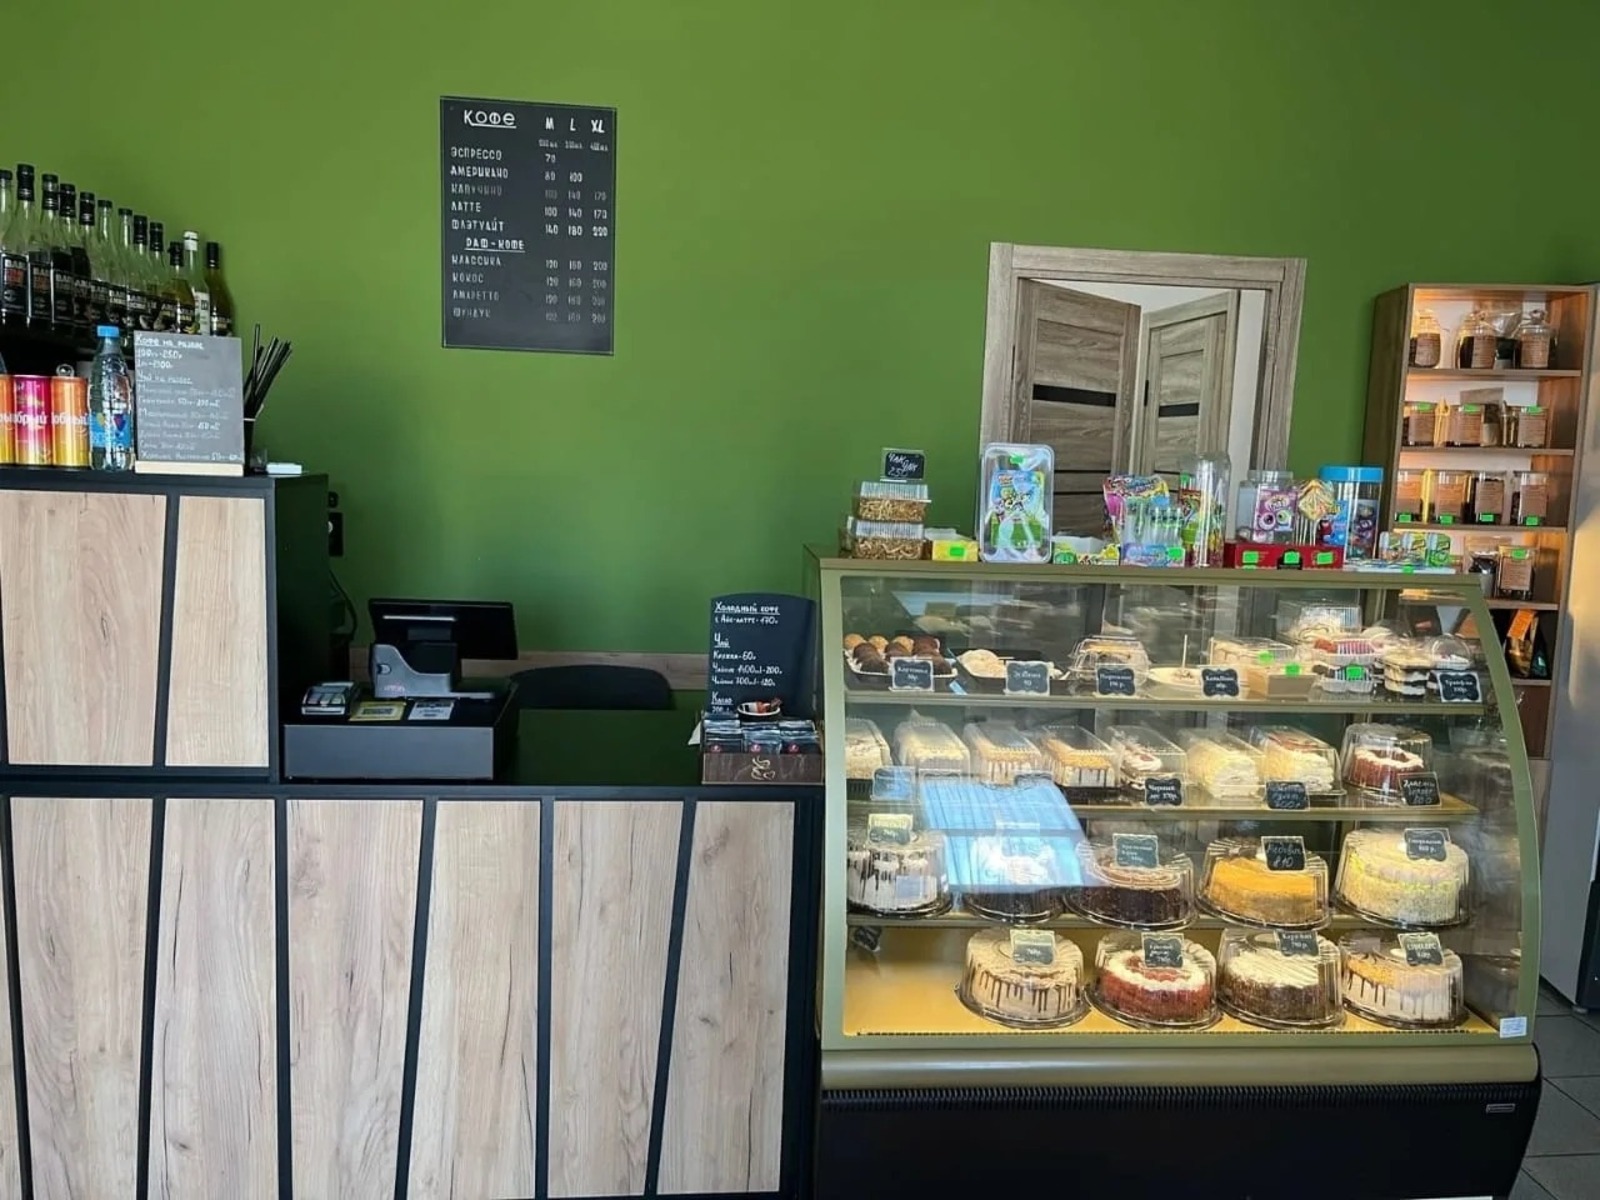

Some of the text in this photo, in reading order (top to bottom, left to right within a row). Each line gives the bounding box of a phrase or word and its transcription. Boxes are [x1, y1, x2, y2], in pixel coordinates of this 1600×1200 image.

[545, 116, 605, 133] M L XL
[450, 147, 502, 160] ЭСПРЕССО
[450, 165, 509, 179] АМЕРИКАНО
[451, 201, 482, 212] ЛАТТЕ
[568, 207, 582, 218] 140
[451, 254, 502, 267] КЛАССИКА
[452, 272, 484, 284] КОКОС
[453, 290, 500, 301] АМАРЕТТО
